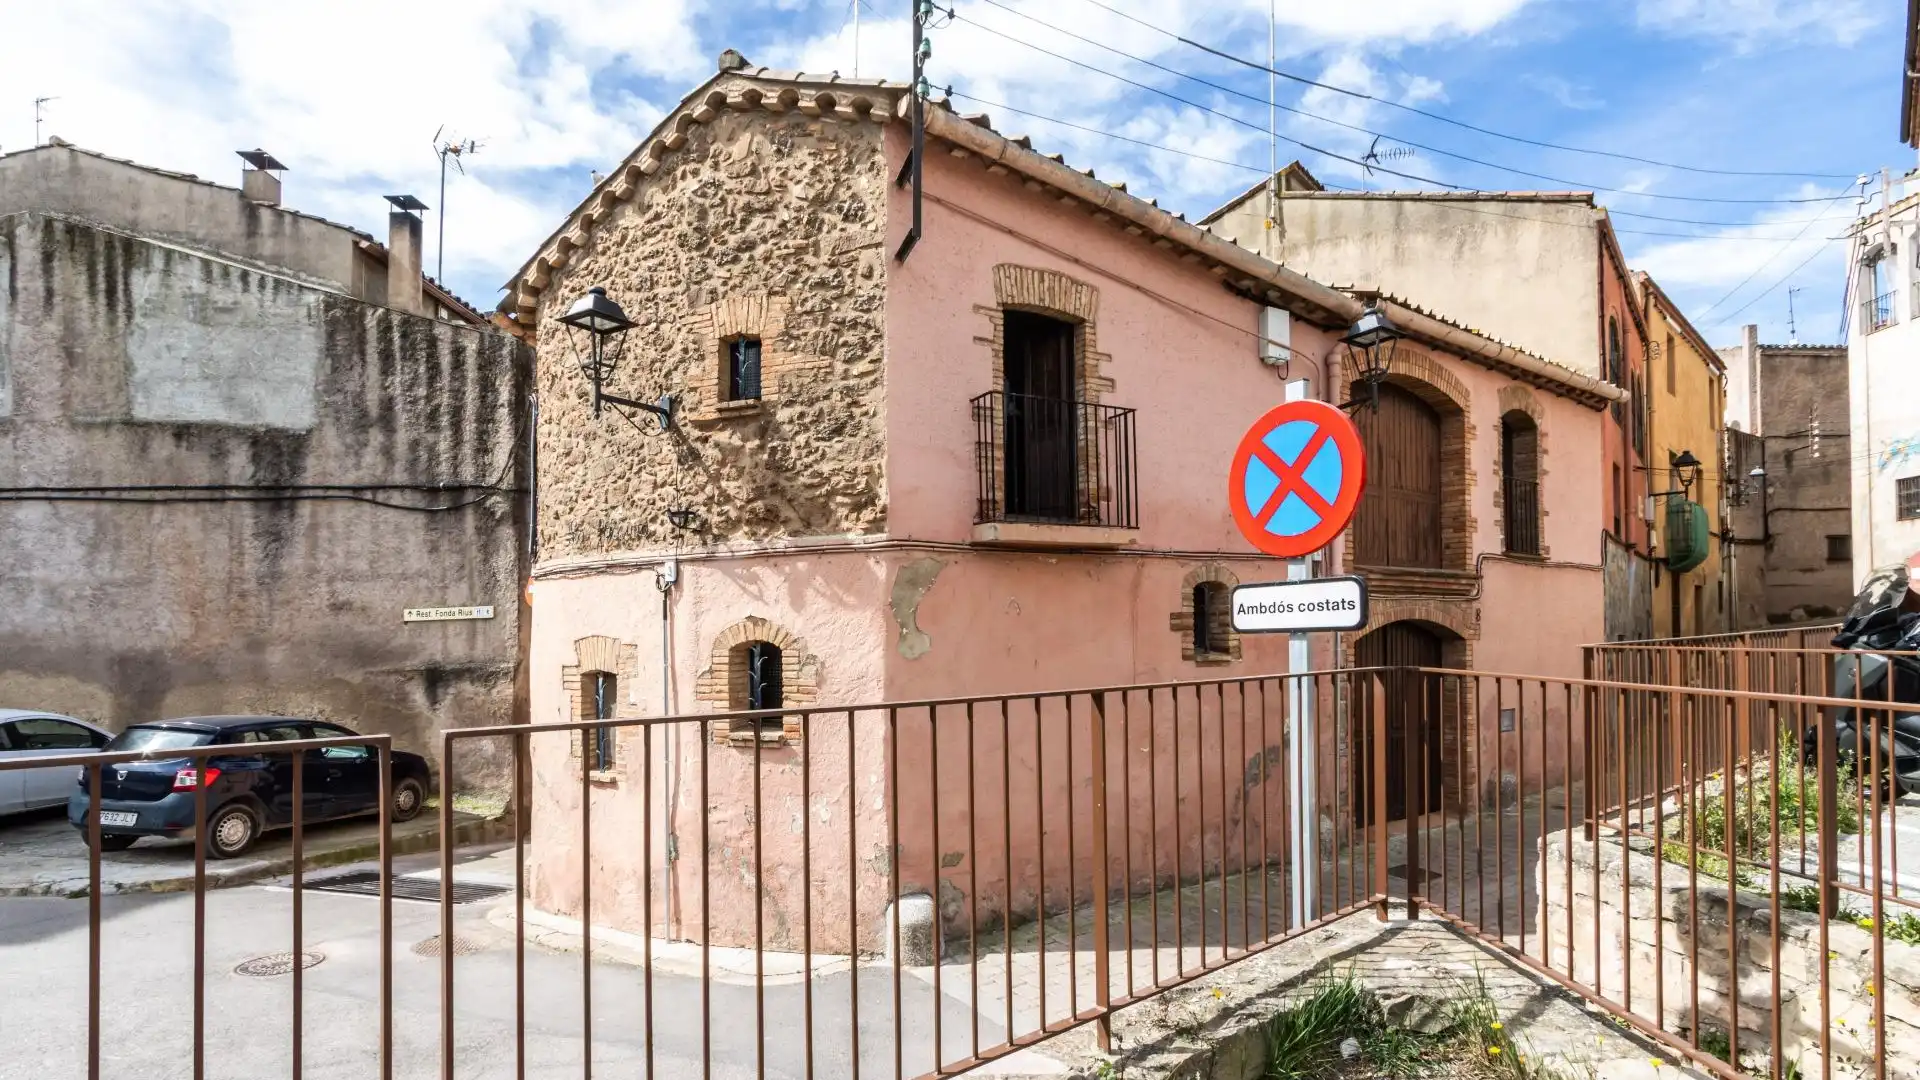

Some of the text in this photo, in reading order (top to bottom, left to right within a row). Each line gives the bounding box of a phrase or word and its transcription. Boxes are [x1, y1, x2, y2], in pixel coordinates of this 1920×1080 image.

[435, 609, 456, 617] Fonda
[458, 608, 473, 616] Rius
[1237, 598, 1356, 615] Ambdós costats
